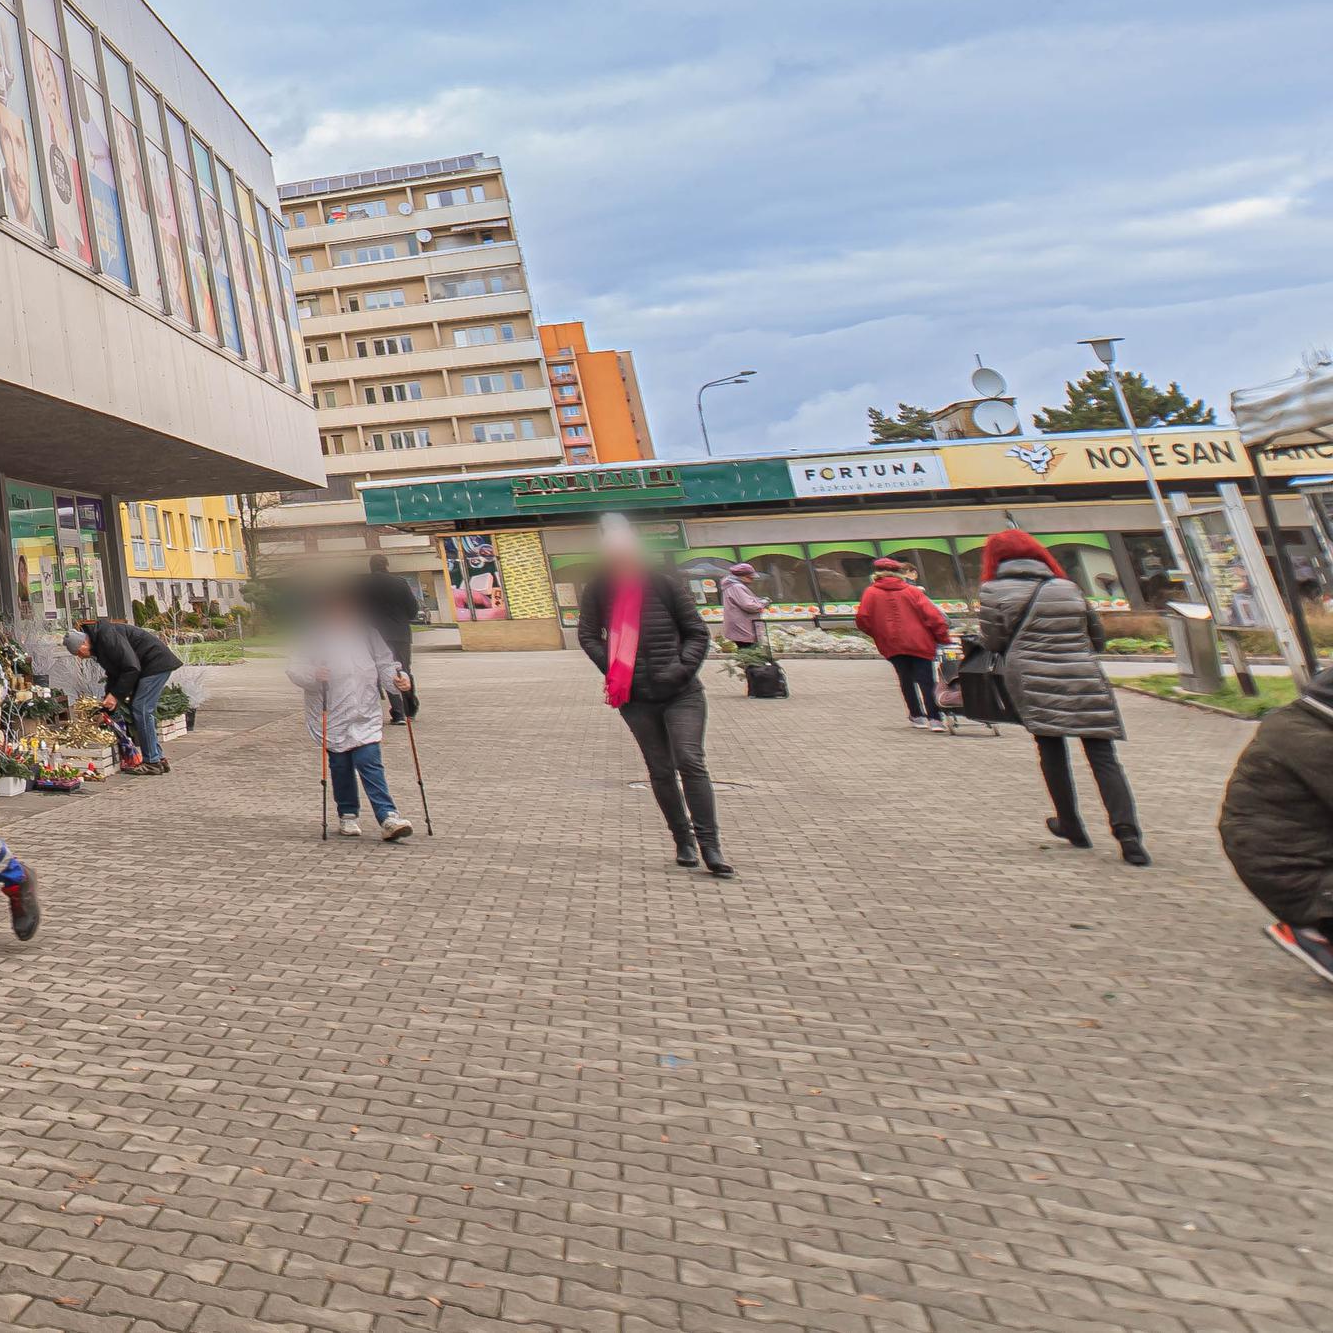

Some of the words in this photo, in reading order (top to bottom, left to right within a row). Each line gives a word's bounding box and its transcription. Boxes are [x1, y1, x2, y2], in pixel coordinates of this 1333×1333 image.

[1085, 437, 1167, 470] NOVÉ
[1173, 441, 1238, 467] SAN
[511, 475, 567, 492] SAN
[572, 467, 681, 490] MARCO
[805, 462, 926, 481] FORTUNA
[812, 482, 863, 494] sázková
[868, 478, 926, 490] kancelář
